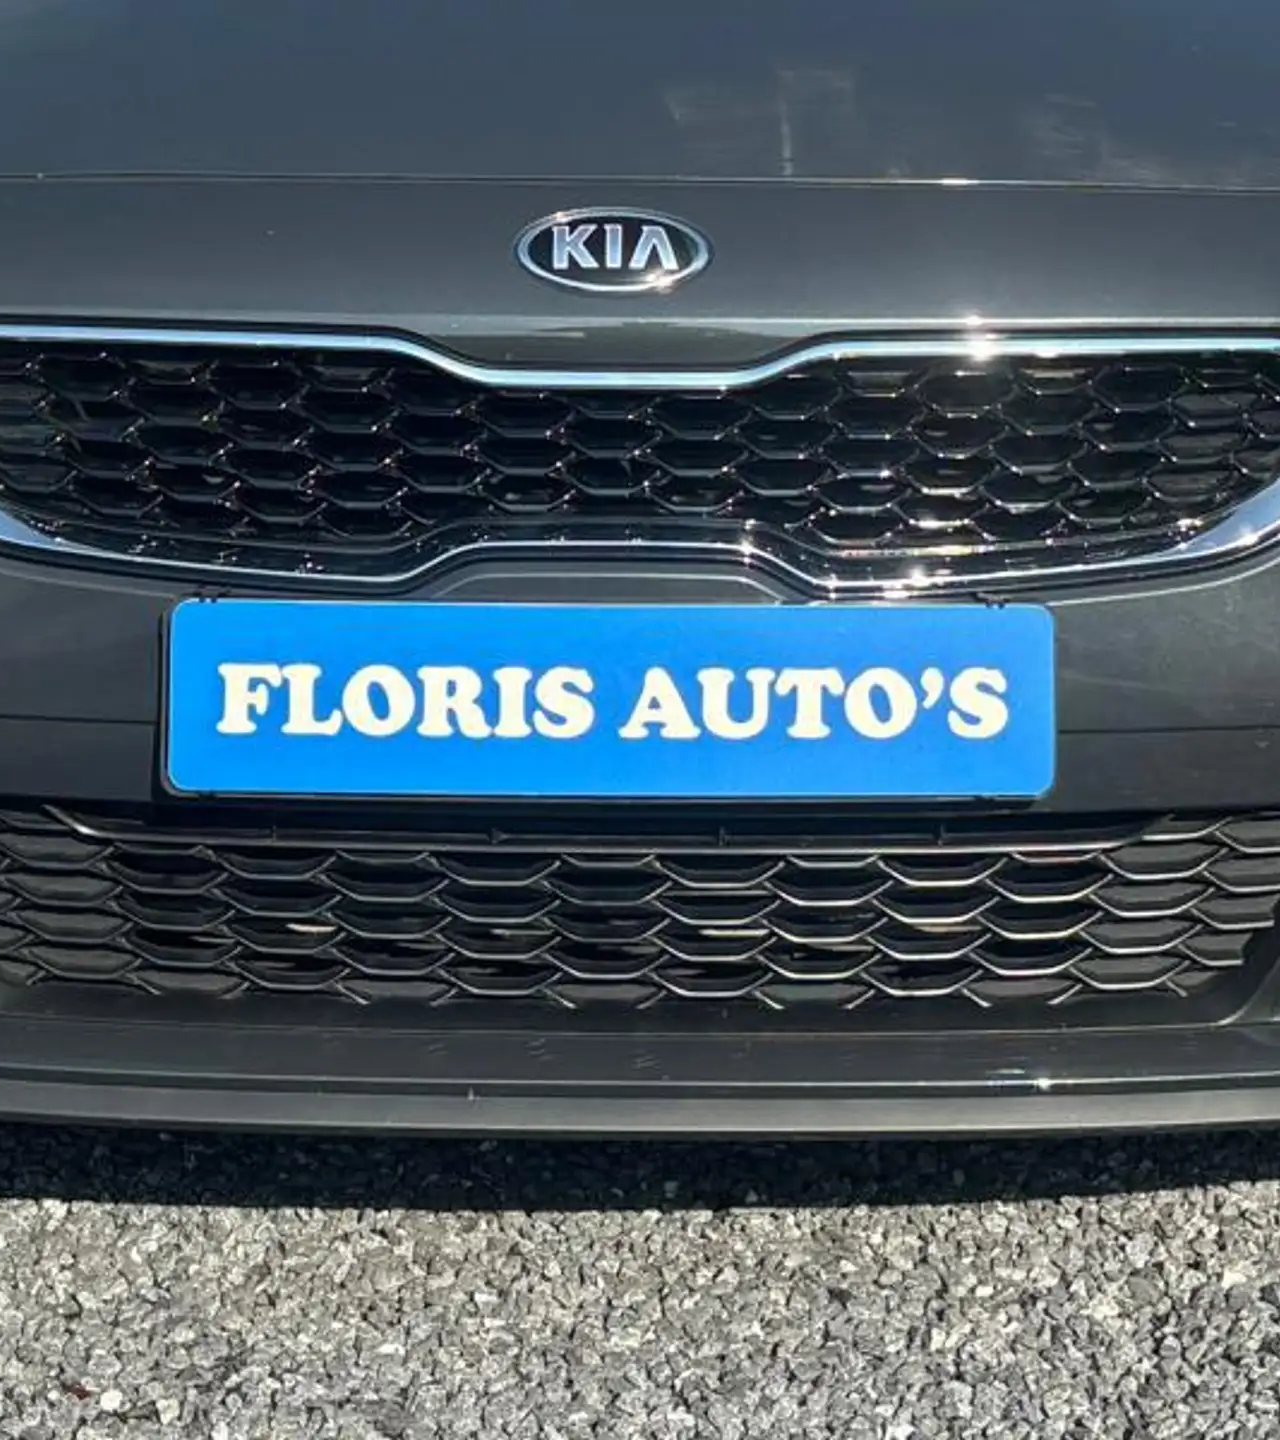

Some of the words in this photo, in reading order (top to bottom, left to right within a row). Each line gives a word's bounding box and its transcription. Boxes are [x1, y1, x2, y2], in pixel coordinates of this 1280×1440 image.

[551, 223, 680, 271] KIA
[216, 663, 595, 739] FLORIS
[618, 666, 1010, 740] AUTO'S
